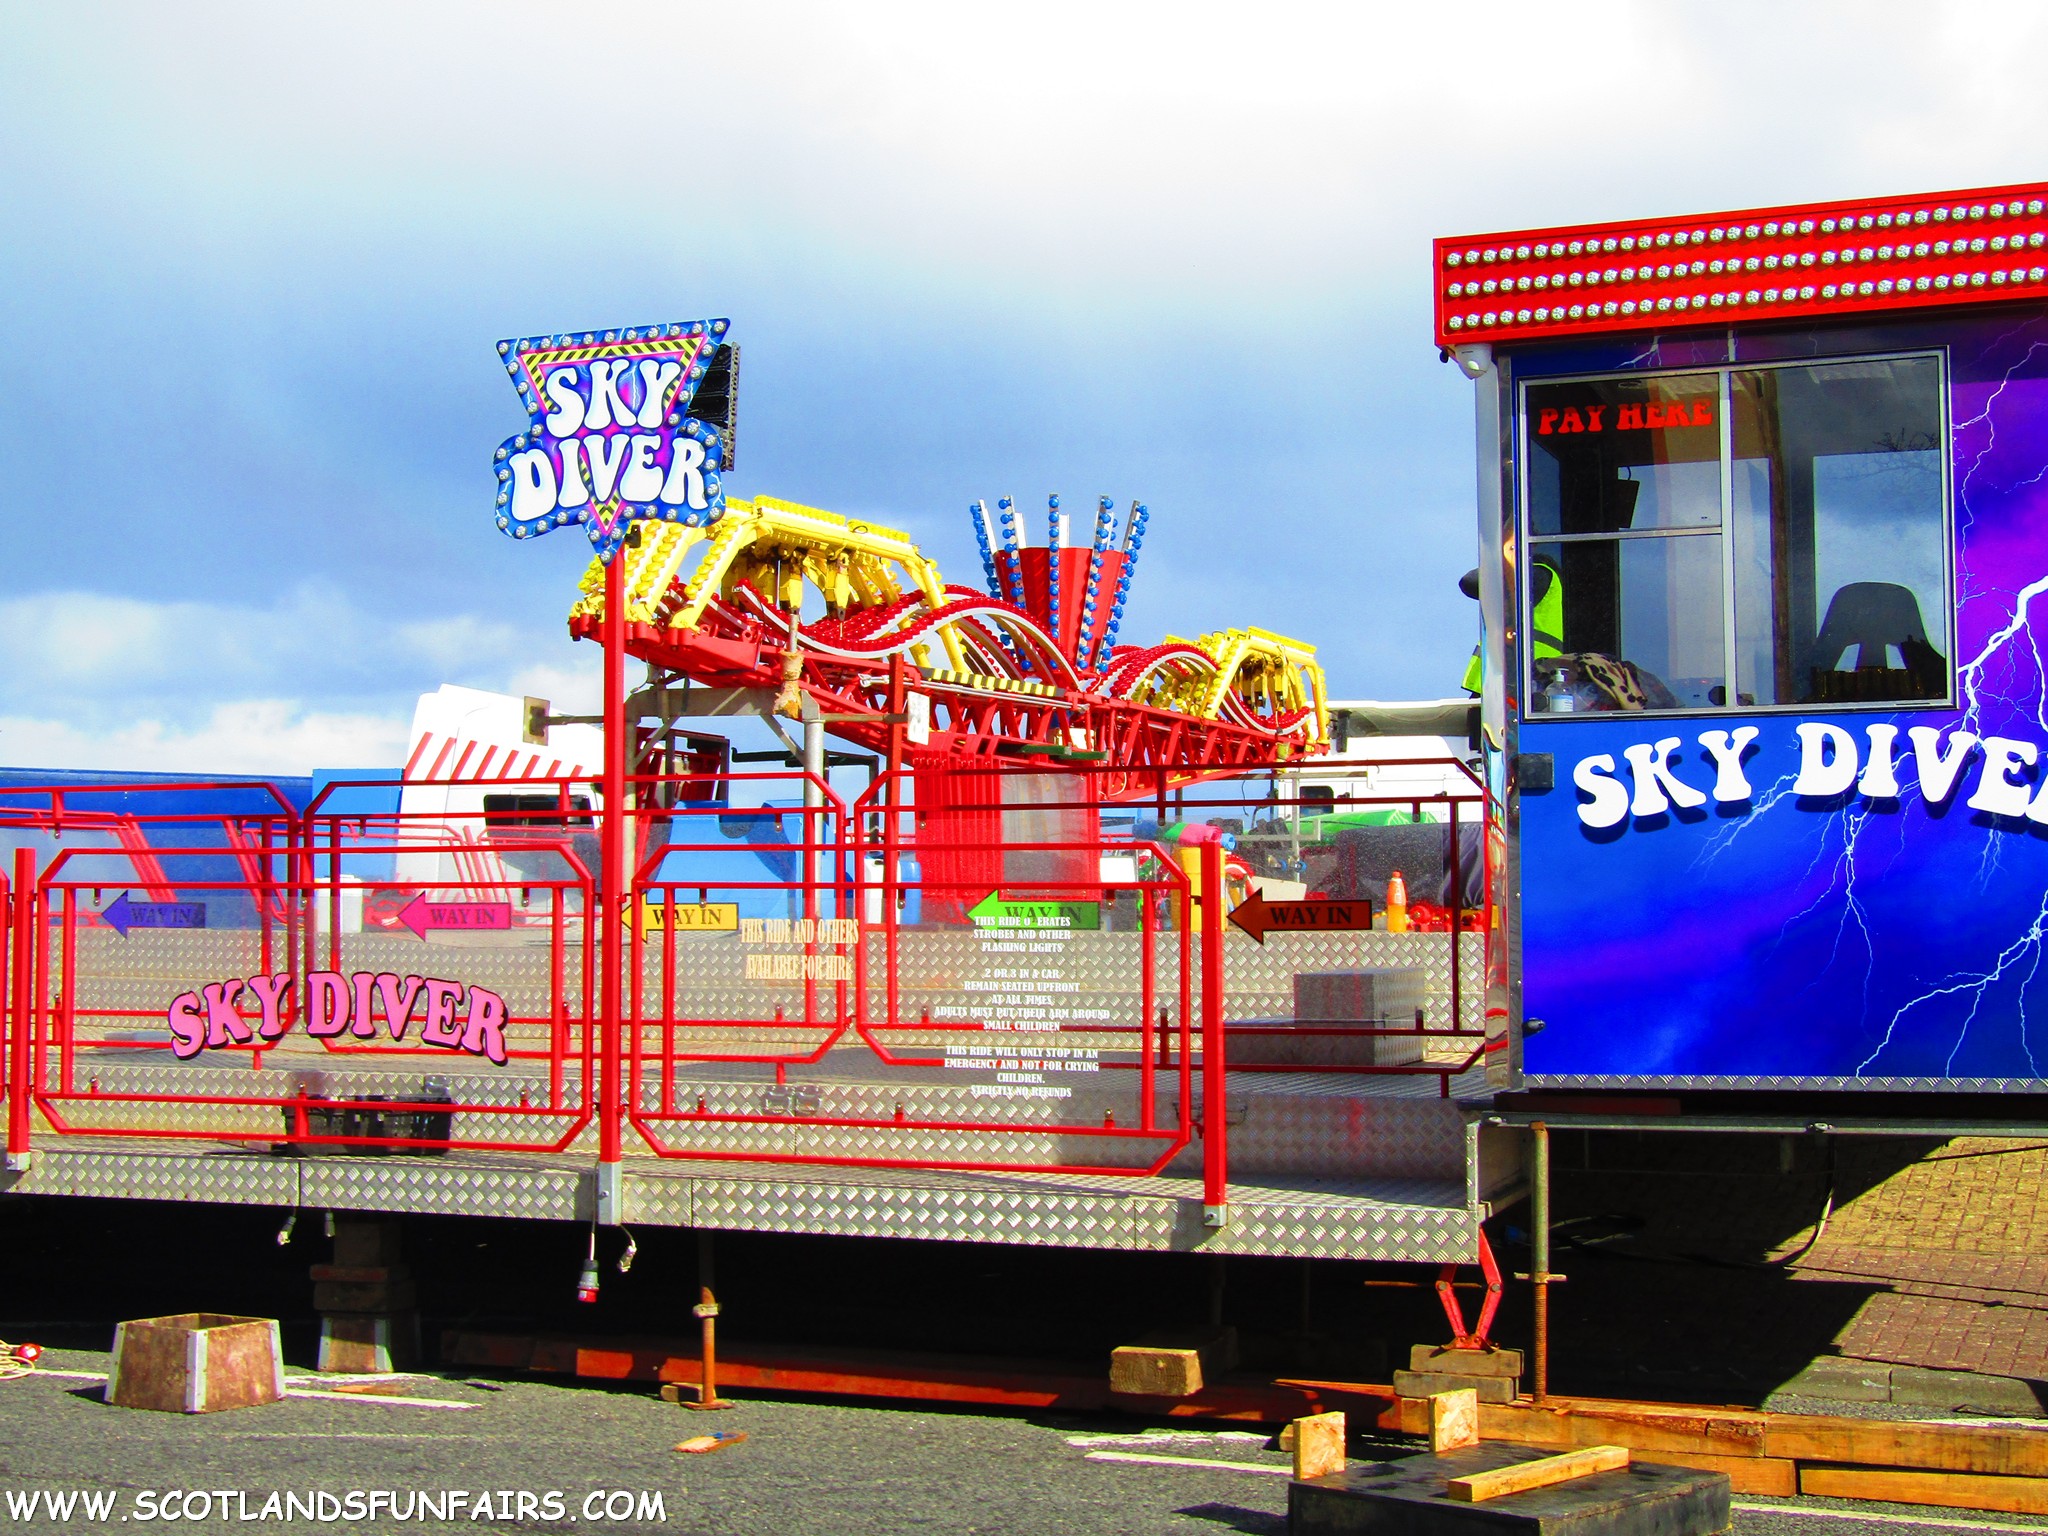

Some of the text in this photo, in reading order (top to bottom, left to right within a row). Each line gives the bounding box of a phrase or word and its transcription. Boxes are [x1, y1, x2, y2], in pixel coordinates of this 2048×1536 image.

[545, 359, 681, 438] SKY
[1538, 401, 1713, 435] PAY HERE
[508, 434, 709, 521] DIVER
[1573, 725, 1760, 829] SKY
[131, 908, 192, 923] WAY IN
[430, 908, 496, 924] WAY IN
[700, 908, 722, 925] IN
[974, 916, 996, 926] THIS
[998, 917, 1021, 926] RIDE
[1269, 906, 1352, 925] WAY IN
[741, 918, 859, 944] THIS RIDE AND OTHERS
[973, 929, 1071, 940] STROBES AND OTHER
[981, 942, 1063, 952] FLASHING LIGHTS
[745, 954, 799, 980] AVAILABLE
[801, 955, 823, 980] FOR
[984, 968, 991, 978] 2
[994, 968, 1008, 978] OR
[1010, 969, 1017, 978] 3
[1019, 969, 1029, 978] IN
[1041, 969, 1060, 979] CAR
[964, 981, 1080, 992] REMAIN SEATED UPFRONT
[992, 994, 1003, 1004] AT
[1006, 994, 1022, 1004] ALL
[168, 971, 508, 1066] SKY DIVER
[934, 1006, 1110, 1019] ADULTS MUST PUT THEIR ARM AROUND
[983, 1020, 1061, 1031] SMALL CHILDREN
[946, 1046, 1098, 1059] THIS RIDE WILL ONLY STOP IN AN
[944, 1058, 1099, 1072] EMERGENCY AND NOT FOR CRYING
[997, 1073, 1045, 1084] CHILDREN.
[970, 1085, 1072, 1097] STRICTLY NO REFUNDS
